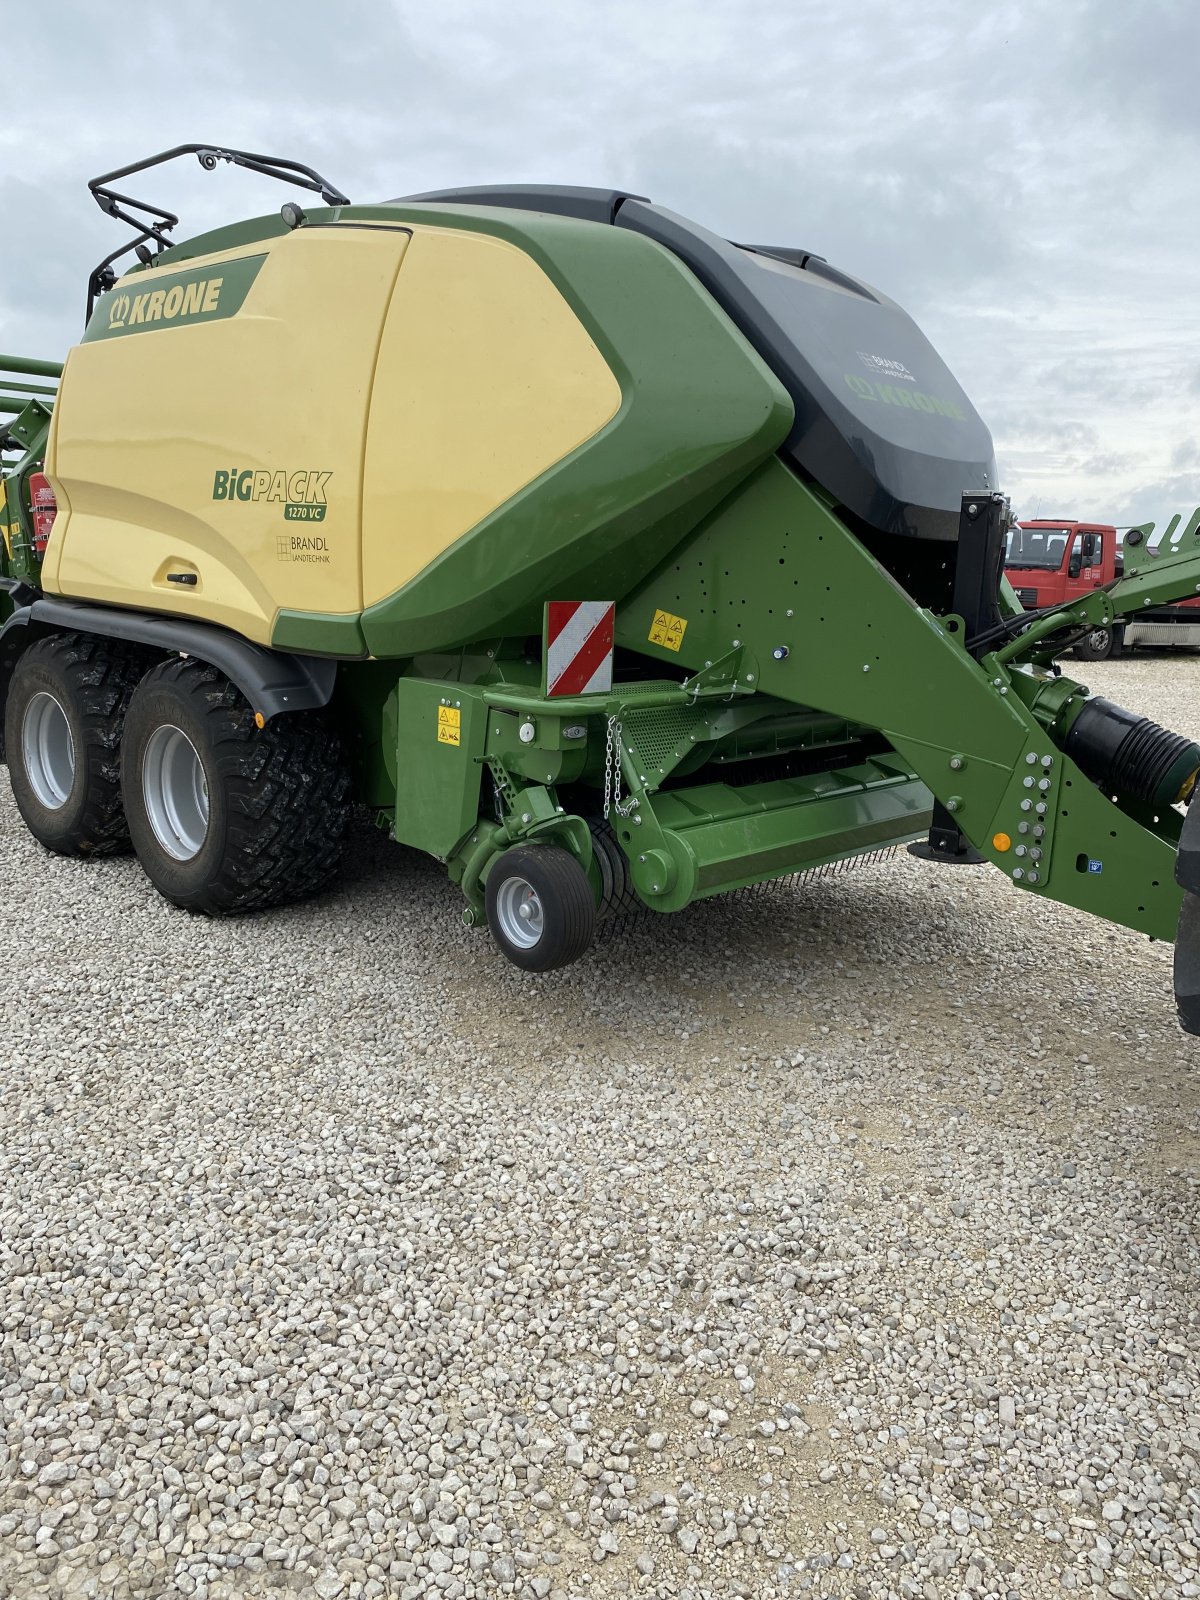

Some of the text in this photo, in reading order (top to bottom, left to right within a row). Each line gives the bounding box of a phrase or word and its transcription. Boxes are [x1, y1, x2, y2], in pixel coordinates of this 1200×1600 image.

[128, 278, 224, 325] KRONE
[874, 383, 967, 421] KRONE
[288, 507, 322, 519] 1270 VC
[291, 536, 329, 551] BRANDL
[292, 554, 331, 563] LANDTECHNIK
